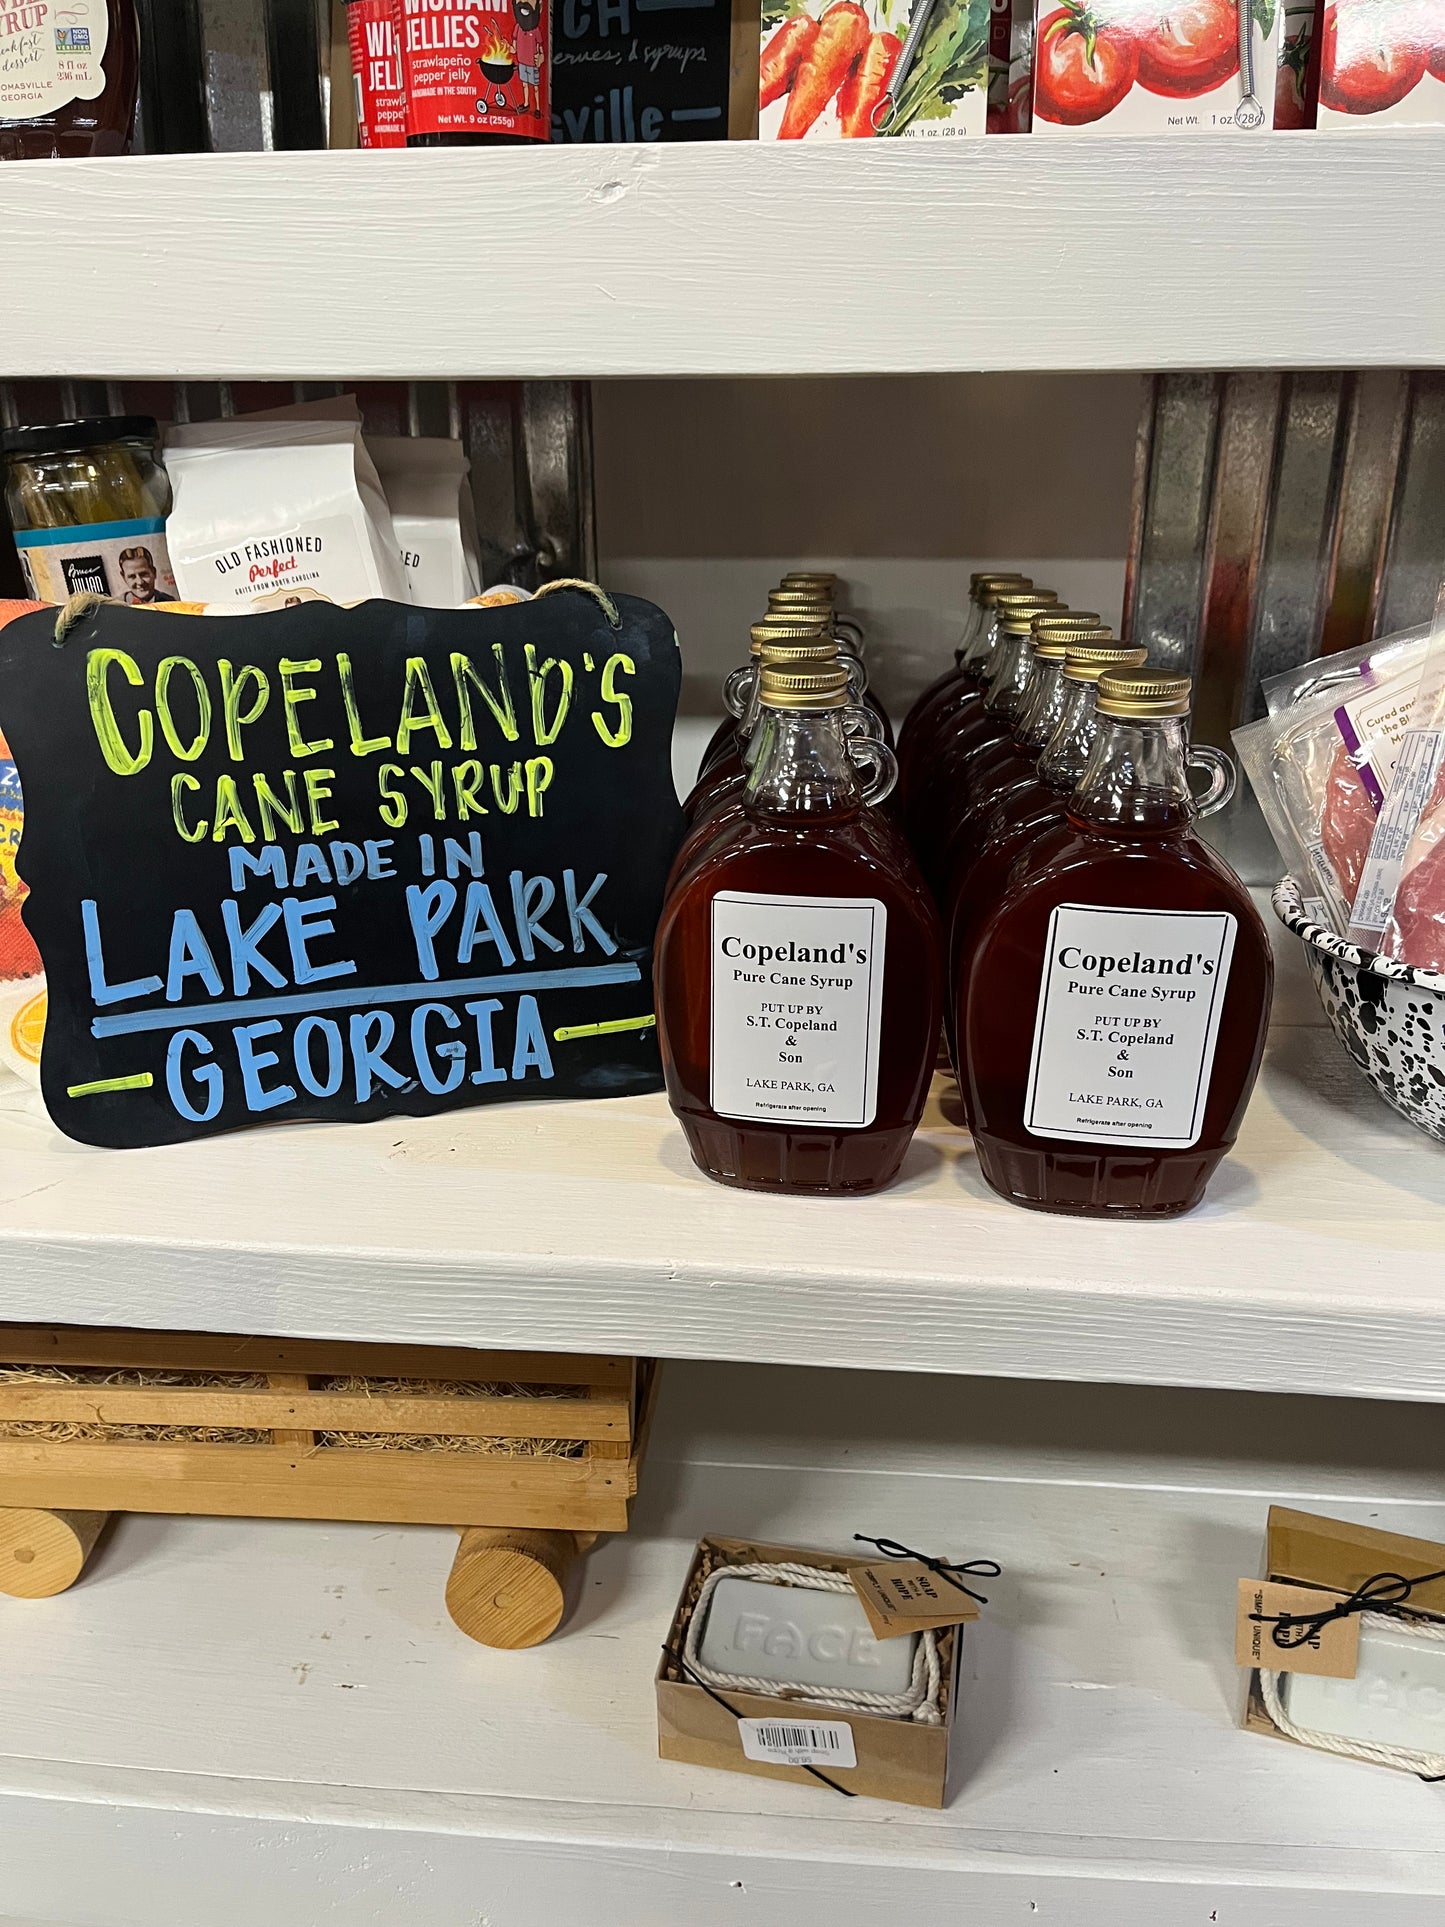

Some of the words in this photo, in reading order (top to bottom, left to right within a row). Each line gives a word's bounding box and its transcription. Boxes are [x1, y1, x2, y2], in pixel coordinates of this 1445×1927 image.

[0, 4, 48, 37] RUP
[366, 21, 396, 57] WI
[406, 15, 480, 53] JELLIES
[2, 47, 45, 72] dessert
[58, 60, 64, 70] 8
[67, 60, 73, 69] fl
[76, 62, 88, 70] oz
[412, 54, 471, 69] strawlapeño
[57, 72, 72, 80] 236
[75, 71, 92, 80] mL
[414, 71, 445, 85] pepper
[448, 68, 471, 83] jelly
[1, 92, 43, 102] GEORGIA
[444, 86, 456, 95] THE
[457, 86, 477, 95] SOUTH
[438, 115, 452, 123] Net
[453, 115, 467, 123] Wt.
[470, 115, 475, 123] 9
[490, 116, 515, 127] (255g)
[1167, 116, 1183, 126] Net
[1186, 114, 1200, 125] Wt.
[1212, 114, 1216, 125] 1
[1220, 116, 1235, 125] oz.
[215, 551, 242, 574] OLD
[244, 536, 322, 562] FASHIONED
[401, 550, 420, 568] ED
[249, 556, 298, 583] Perfect
[234, 586, 252, 596] GRITS
[253, 582, 270, 592] FROM
[270, 577, 290, 588] NORTH
[291, 571, 320, 584] CAROLINA
[87, 643, 635, 775] COPELAND'S
[1366, 707, 1397, 728] Cured
[1381, 723, 1398, 735] the
[171, 769, 340, 843] CANE
[378, 757, 555, 828] SYRUP
[229, 839, 397, 891] MADE
[419, 832, 485, 879] IN
[80, 895, 357, 1006] LAKE
[406, 868, 618, 979] PARK
[721, 937, 867, 966] Copeland's
[1058, 947, 1215, 977] Copeland's
[733, 969, 766, 984] Pure
[770, 973, 806, 986] Cane
[810, 975, 853, 990] Syrup
[1067, 981, 1104, 996] Pure
[1108, 984, 1147, 998] Cane
[1151, 986, 1196, 1002] Syrup
[761, 1003, 785, 1013] PUT
[788, 1004, 804, 1014] UP
[806, 1005, 823, 1015] BY
[746, 1015, 771, 1028] S.T.
[775, 1017, 837, 1032] Copeland
[1094, 1016, 1121, 1027] PUT
[1124, 1018, 1141, 1028] UP
[1143, 1018, 1161, 1028] BY
[785, 1035, 797, 1046] &
[1076, 1028, 1103, 1042] S.T.
[1108, 1031, 1174, 1046] Copeland
[166, 995, 554, 1121] GEORGIA
[778, 1051, 803, 1063] Son
[1117, 1049, 1130, 1061] &
[1107, 1066, 1133, 1078] Son
[746, 1078, 778, 1090] LAKE
[780, 1081, 815, 1093] PARK,
[818, 1083, 835, 1093] GA
[755, 1102, 787, 1110] Refrigerate
[1069, 1092, 1103, 1105] LAKE
[1106, 1096, 1142, 1109] PARK,
[1145, 1098, 1164, 1108] GA
[1076, 1117, 1110, 1125] Refrigerate
[890, 1579, 914, 1600] ROPE
[916, 1576, 938, 1598] SOAP
[1254, 1589, 1263, 1623] "SIMP
[733, 1611, 882, 1668] FACE
[1252, 1625, 1262, 1660] UNIQUE"
